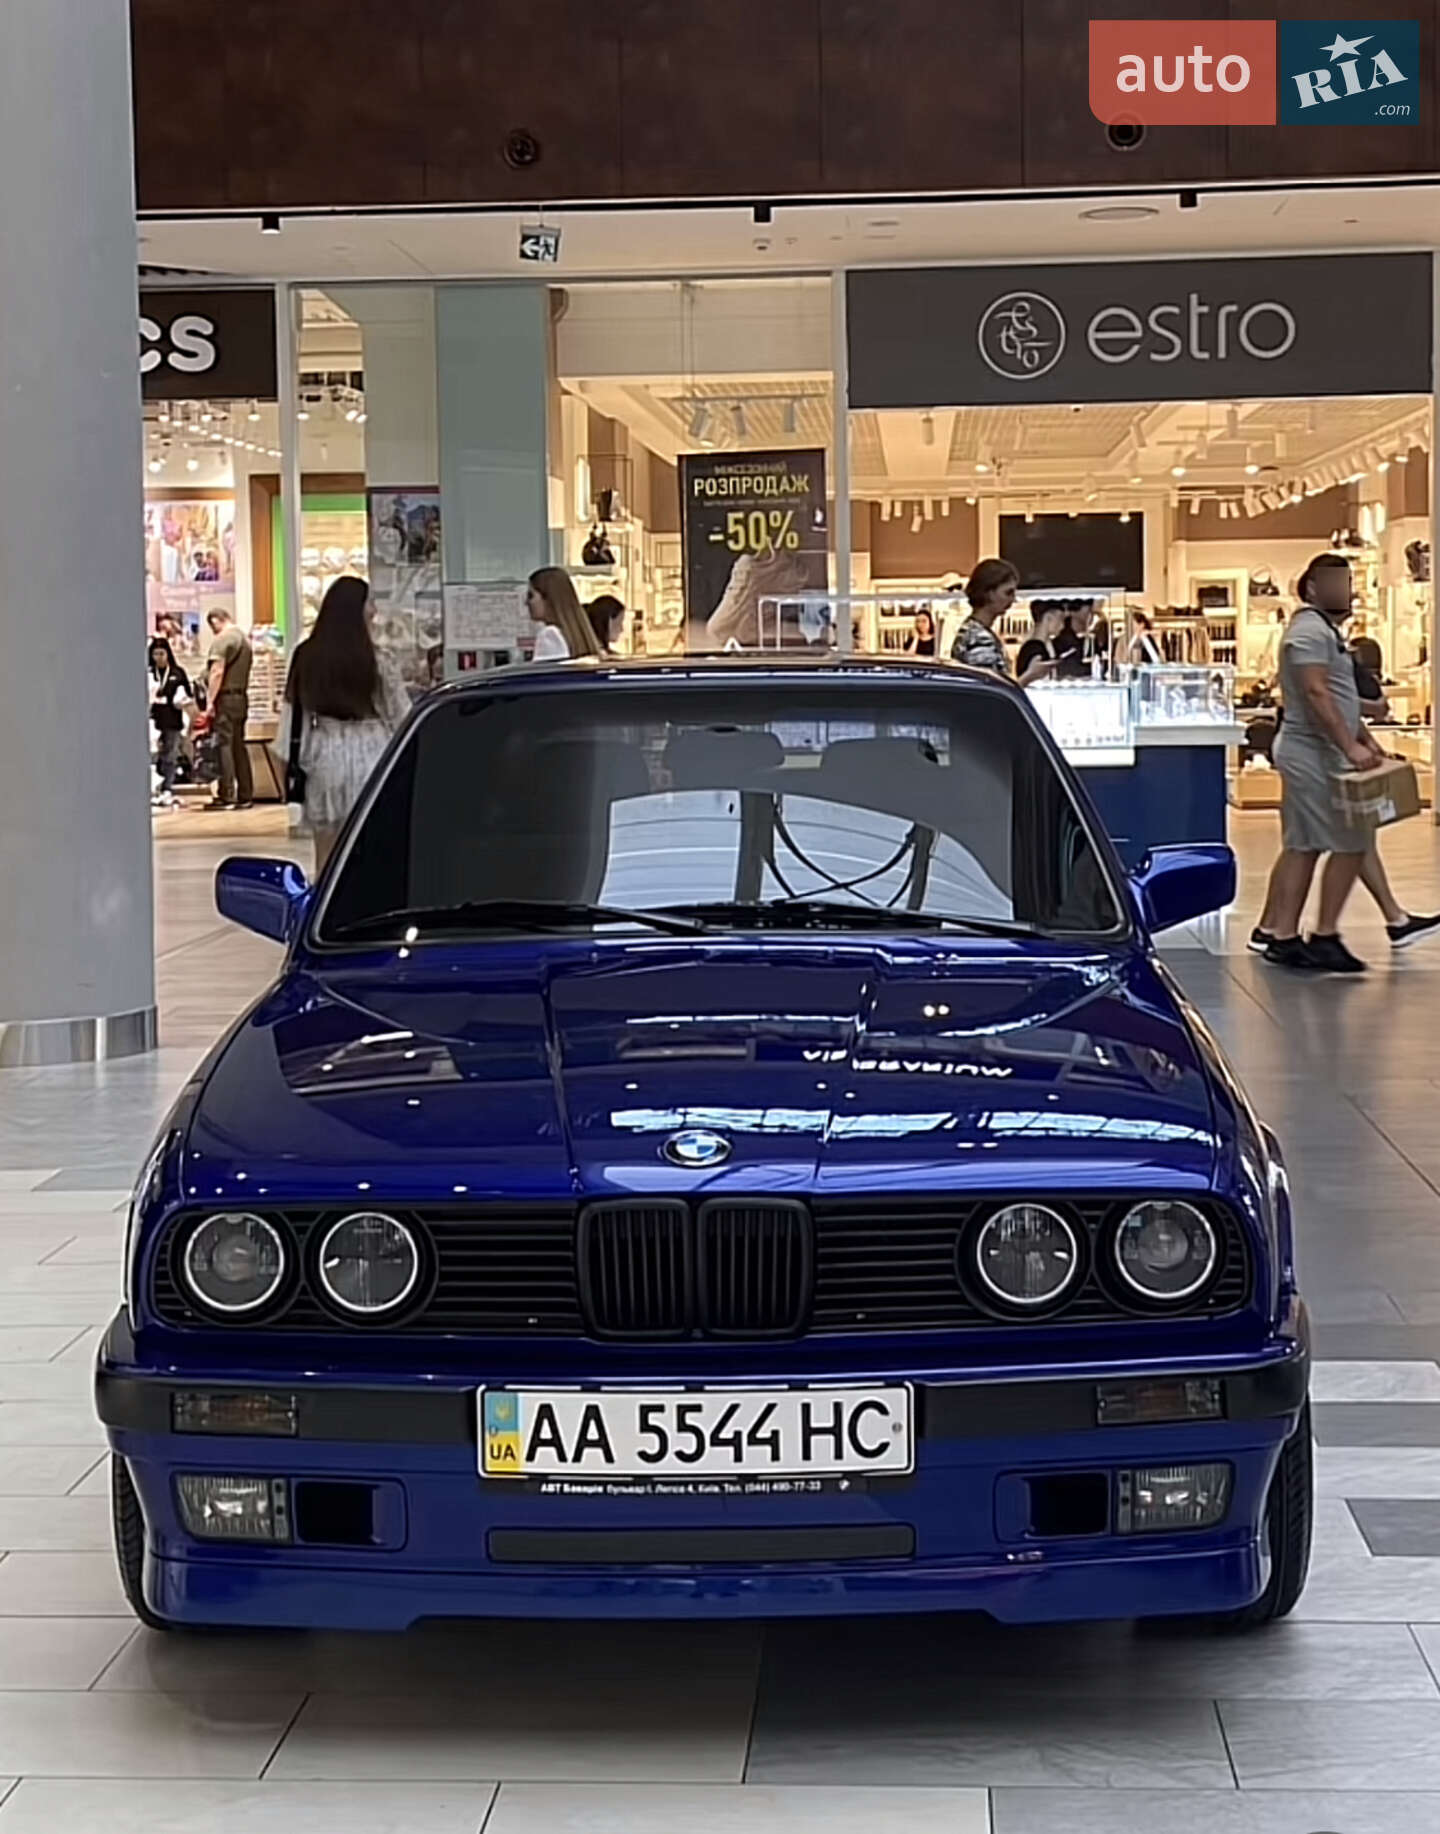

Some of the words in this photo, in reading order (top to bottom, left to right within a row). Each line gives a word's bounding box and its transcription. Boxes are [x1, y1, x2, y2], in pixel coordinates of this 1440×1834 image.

[1087, 292, 1297, 364] estro
[693, 474, 810, 497] РОЗПРОДАЖ
[708, 509, 800, 552] -50%
[489, 1443, 517, 1462] UA
[525, 1403, 615, 1464] AA
[637, 1403, 780, 1464] 5544
[802, 1399, 891, 1460] HC
